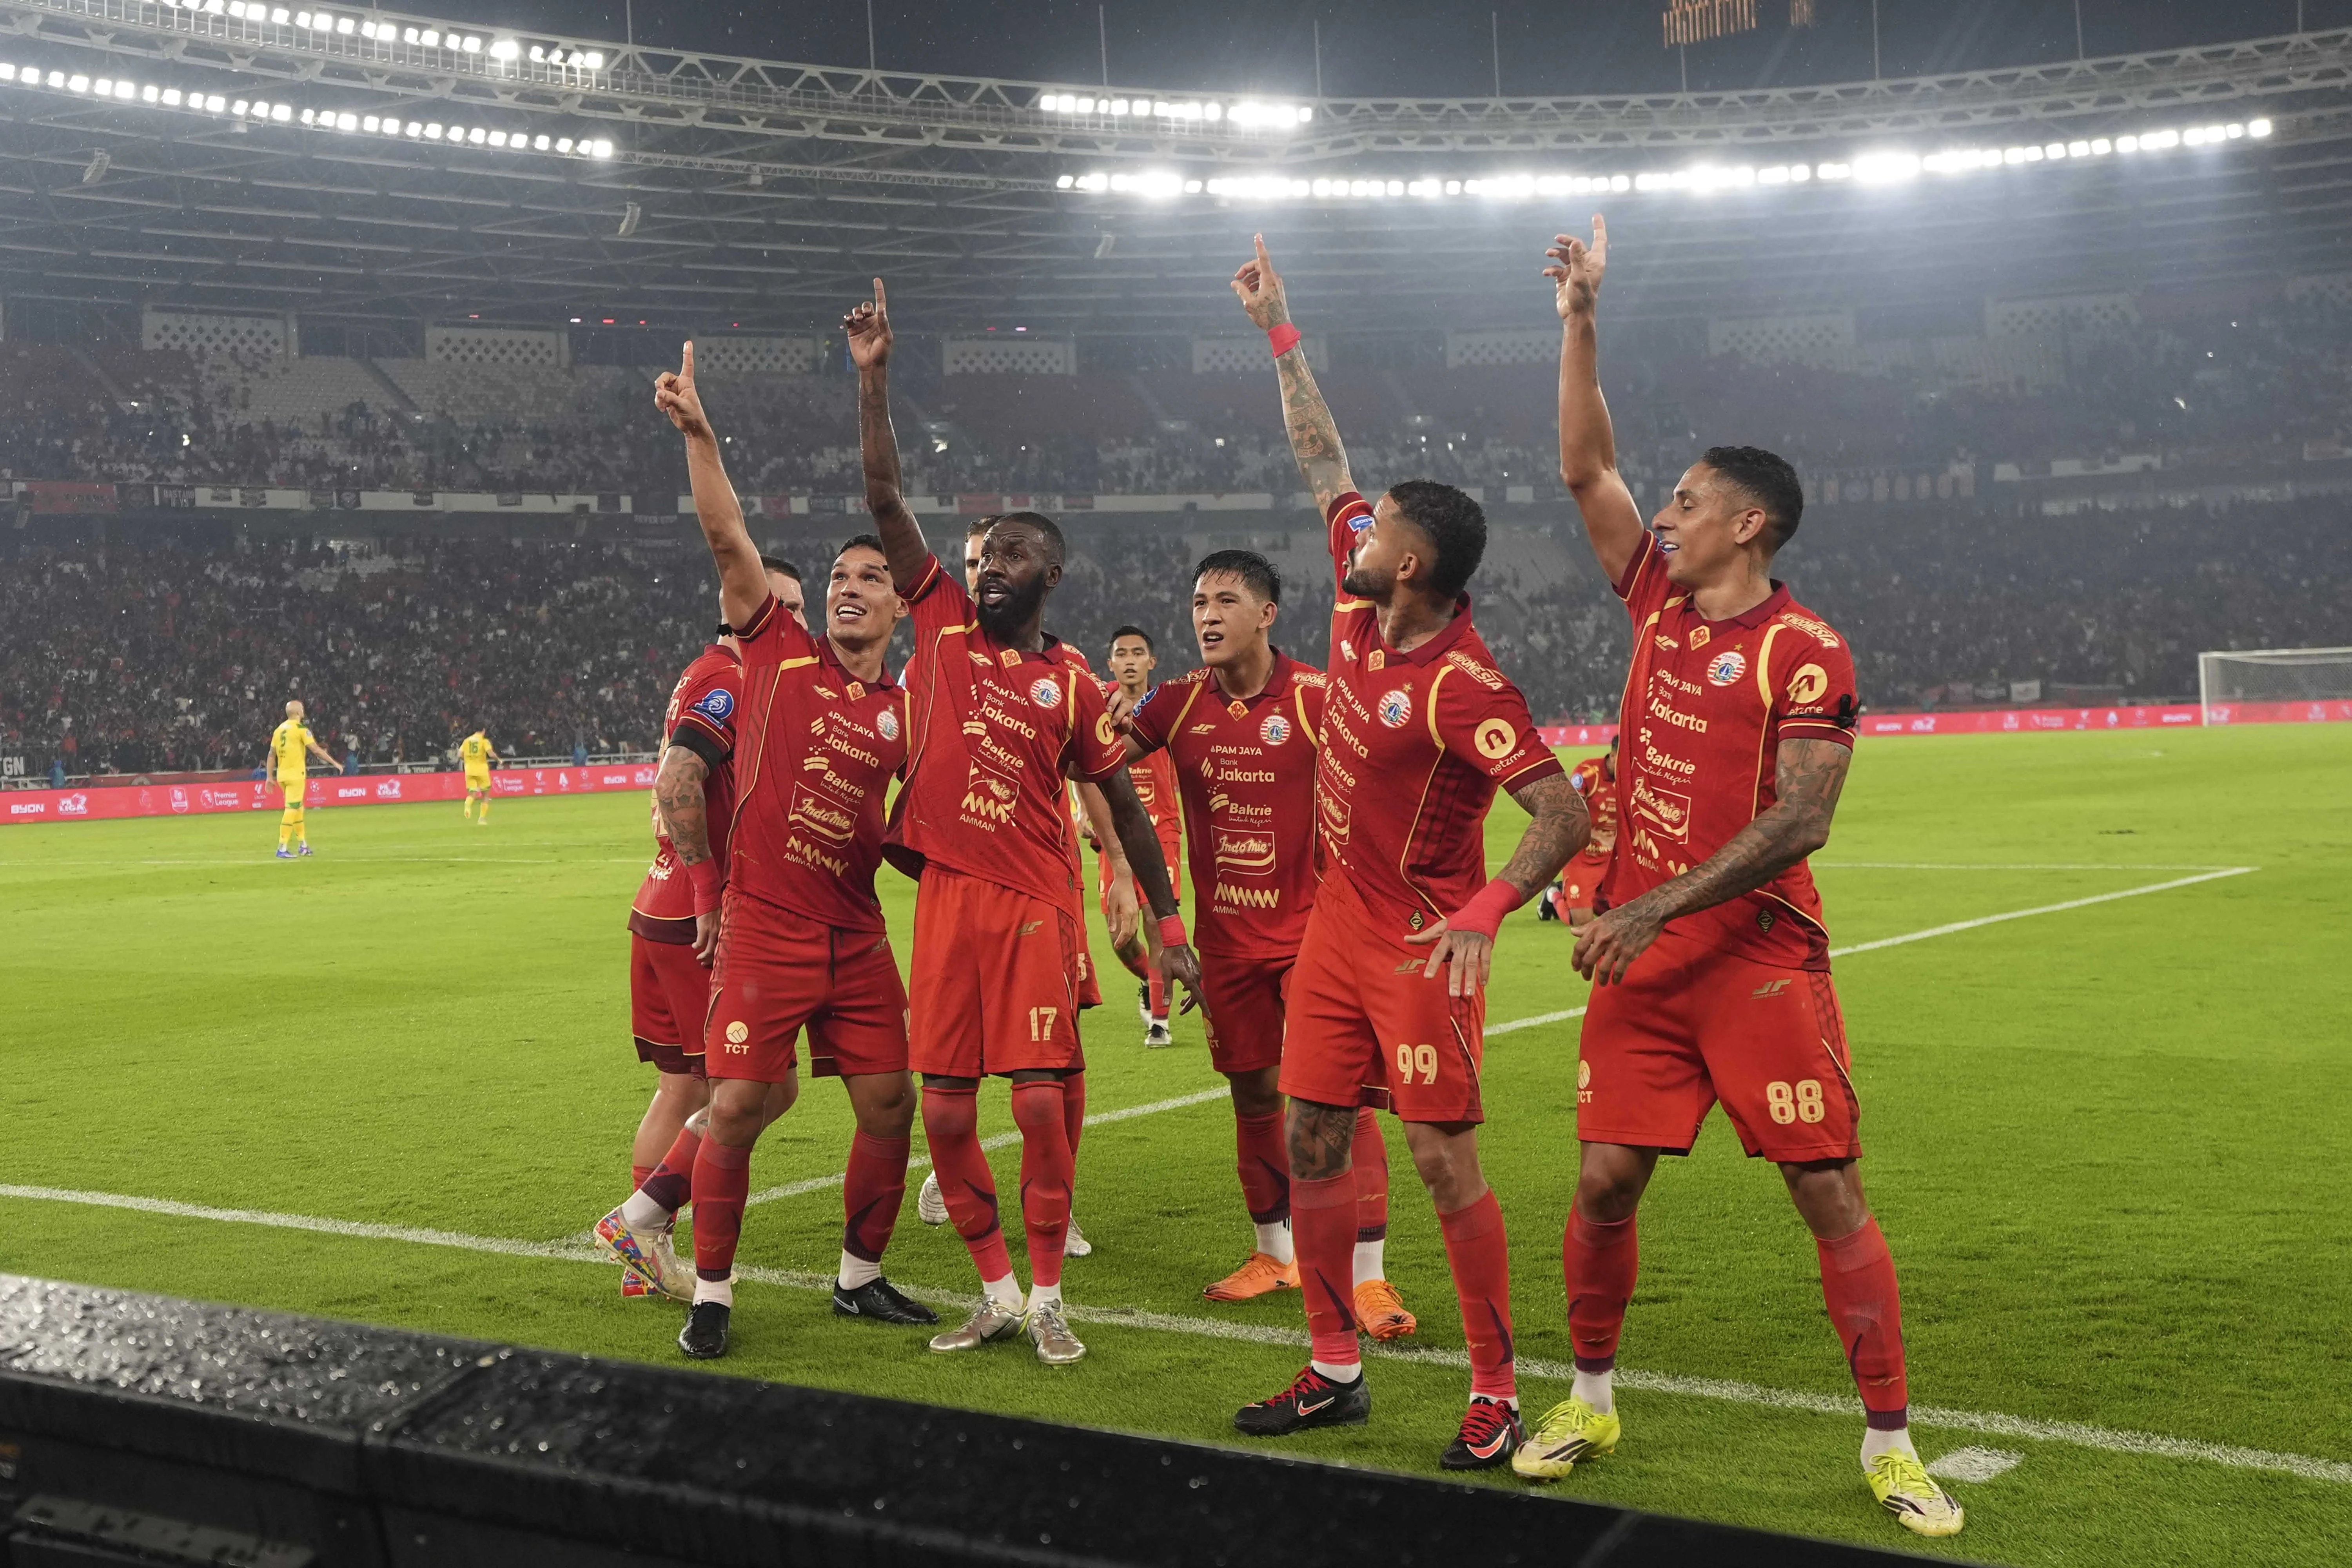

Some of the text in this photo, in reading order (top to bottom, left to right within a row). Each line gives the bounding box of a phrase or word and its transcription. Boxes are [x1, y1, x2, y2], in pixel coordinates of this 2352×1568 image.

[987, 680, 1009, 697] PAM
[1392, 692, 1408, 705] PERSIJA
[1679, 681, 1702, 696] JAYA
[986, 693, 1005, 707] Bank
[1336, 696, 1347, 715] Bank
[1339, 680, 1370, 724] PAM JAYA
[980, 701, 1036, 740] Jakarta
[1650, 697, 1708, 733] Jakarta
[1788, 706, 1824, 715] etzme
[832, 725, 849, 739] Bank
[833, 712, 874, 740] PAM JAYA
[1328, 705, 1368, 759] Jakarta
[468, 741, 478, 753] 16
[825, 733, 879, 768] Jakarta
[981, 736, 1024, 768] Bakrie
[1102, 739, 1122, 759] netzme
[1216, 745, 1262, 755] PAM JAYA
[1324, 746, 1356, 787] Bakrie
[1490, 749, 1526, 775] netzme
[1646, 746, 1696, 775] Bakrie
[823, 770, 864, 798] Bakrie
[1217, 768, 1275, 782] Jakarta
[11, 804, 44, 814] BYON
[1229, 803, 1272, 815] Bakrie
[959, 813, 995, 832] AMMAN
[1029, 1007, 1057, 1041] 17
[724, 1044, 750, 1054] TCT
[1397, 1044, 1438, 1085] 99
[1766, 1079, 1825, 1124] 88
